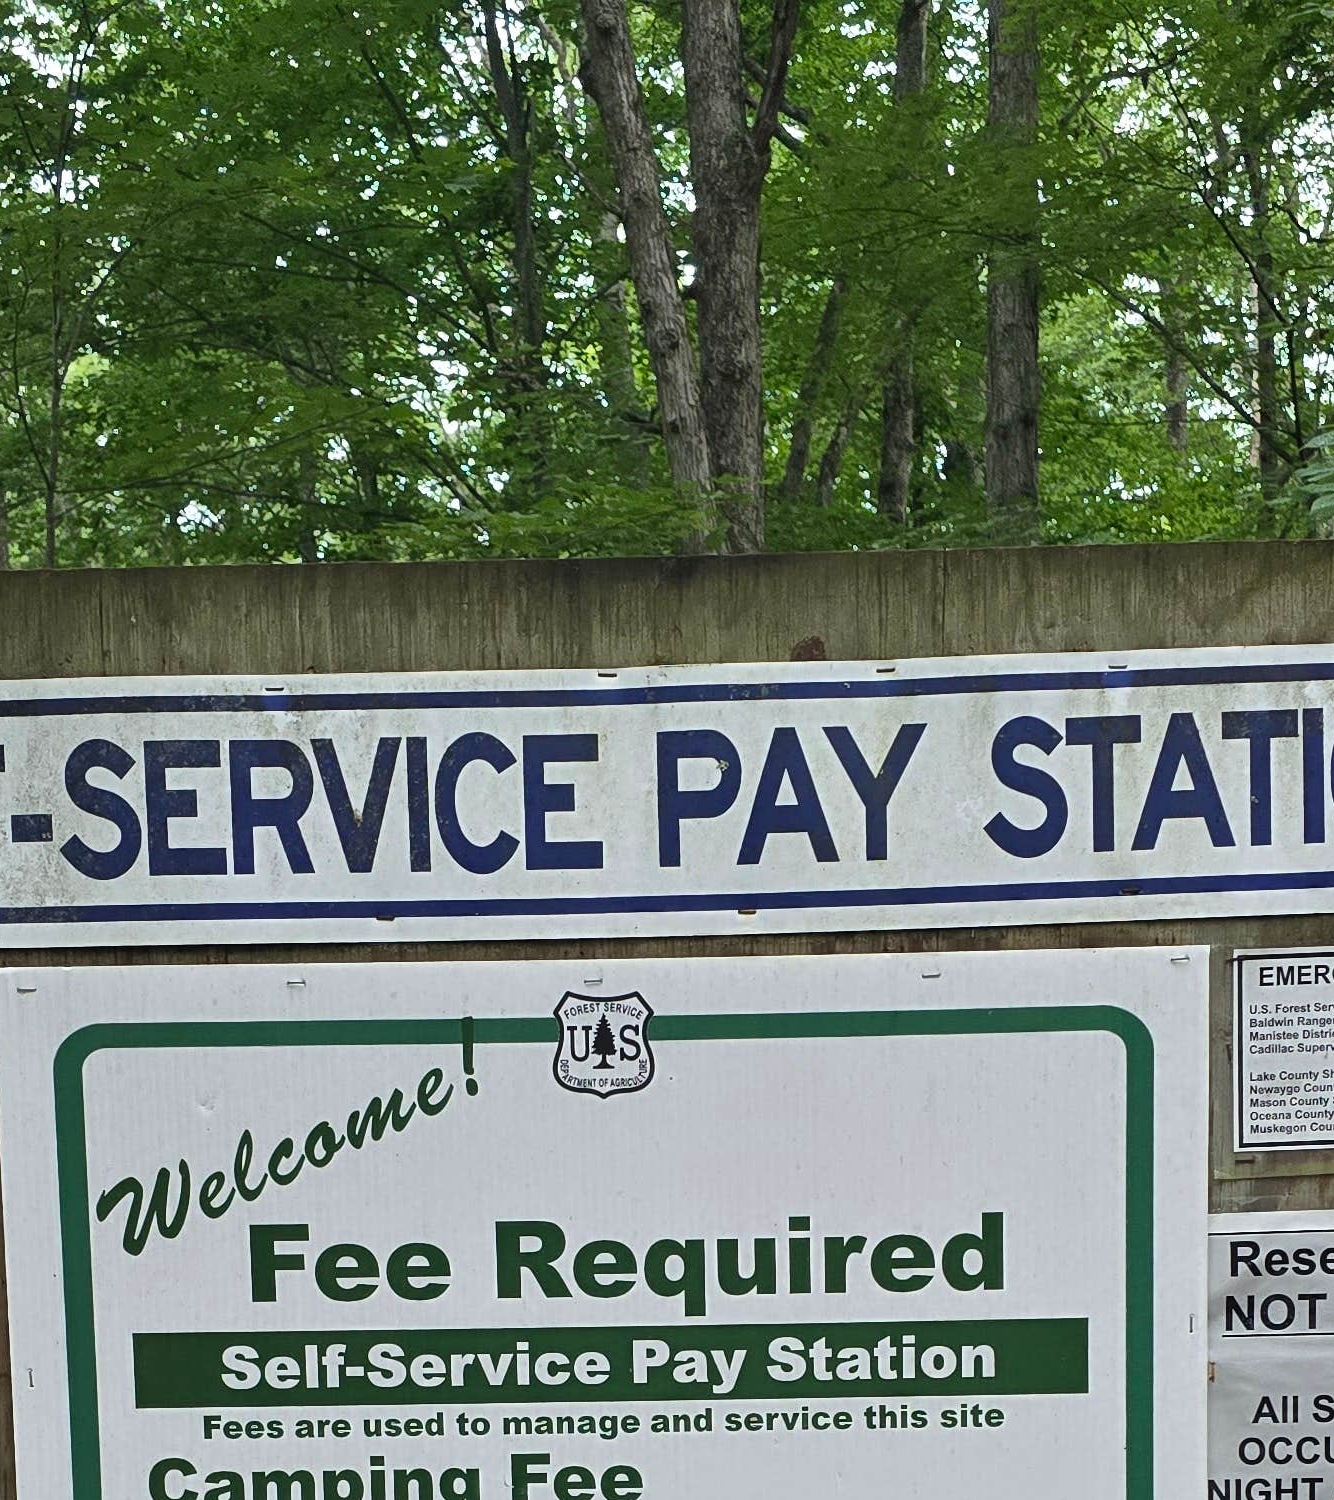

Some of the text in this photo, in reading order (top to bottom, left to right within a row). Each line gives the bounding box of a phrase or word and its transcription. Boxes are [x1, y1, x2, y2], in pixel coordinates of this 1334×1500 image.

[657, 722, 927, 868] PAY
[1250, 1017, 1297, 1027] Baldwin
[1250, 1071, 1276, 1082] Lake
[1279, 1071, 1319, 1082] County
[97, 1015, 482, 1256] Welcome!
[248, 1213, 1006, 1316] Fee Required
[1225, 1294, 1327, 1331] NOT
[220, 1333, 996, 1396] Self-Service Pay Station
[202, 1403, 1005, 1442] Fees are used to manage and service this site
